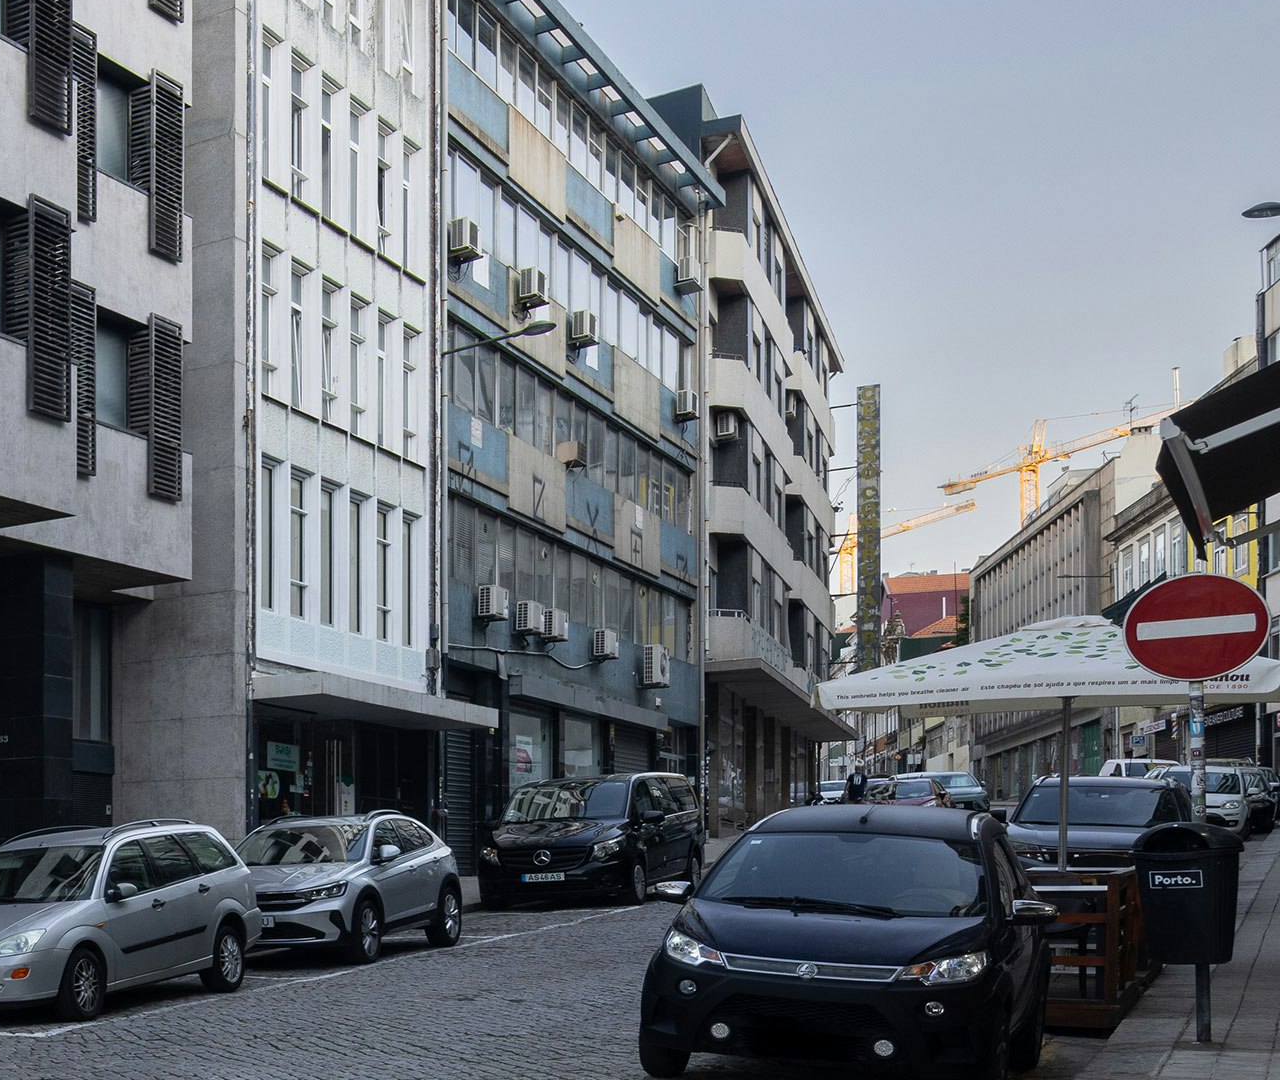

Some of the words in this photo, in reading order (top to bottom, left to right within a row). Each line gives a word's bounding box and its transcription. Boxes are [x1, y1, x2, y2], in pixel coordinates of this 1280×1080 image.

[859, 388, 878, 480] CENTRO
[853, 776, 862, 785] 10
[1154, 875, 1196, 884] Porto.
